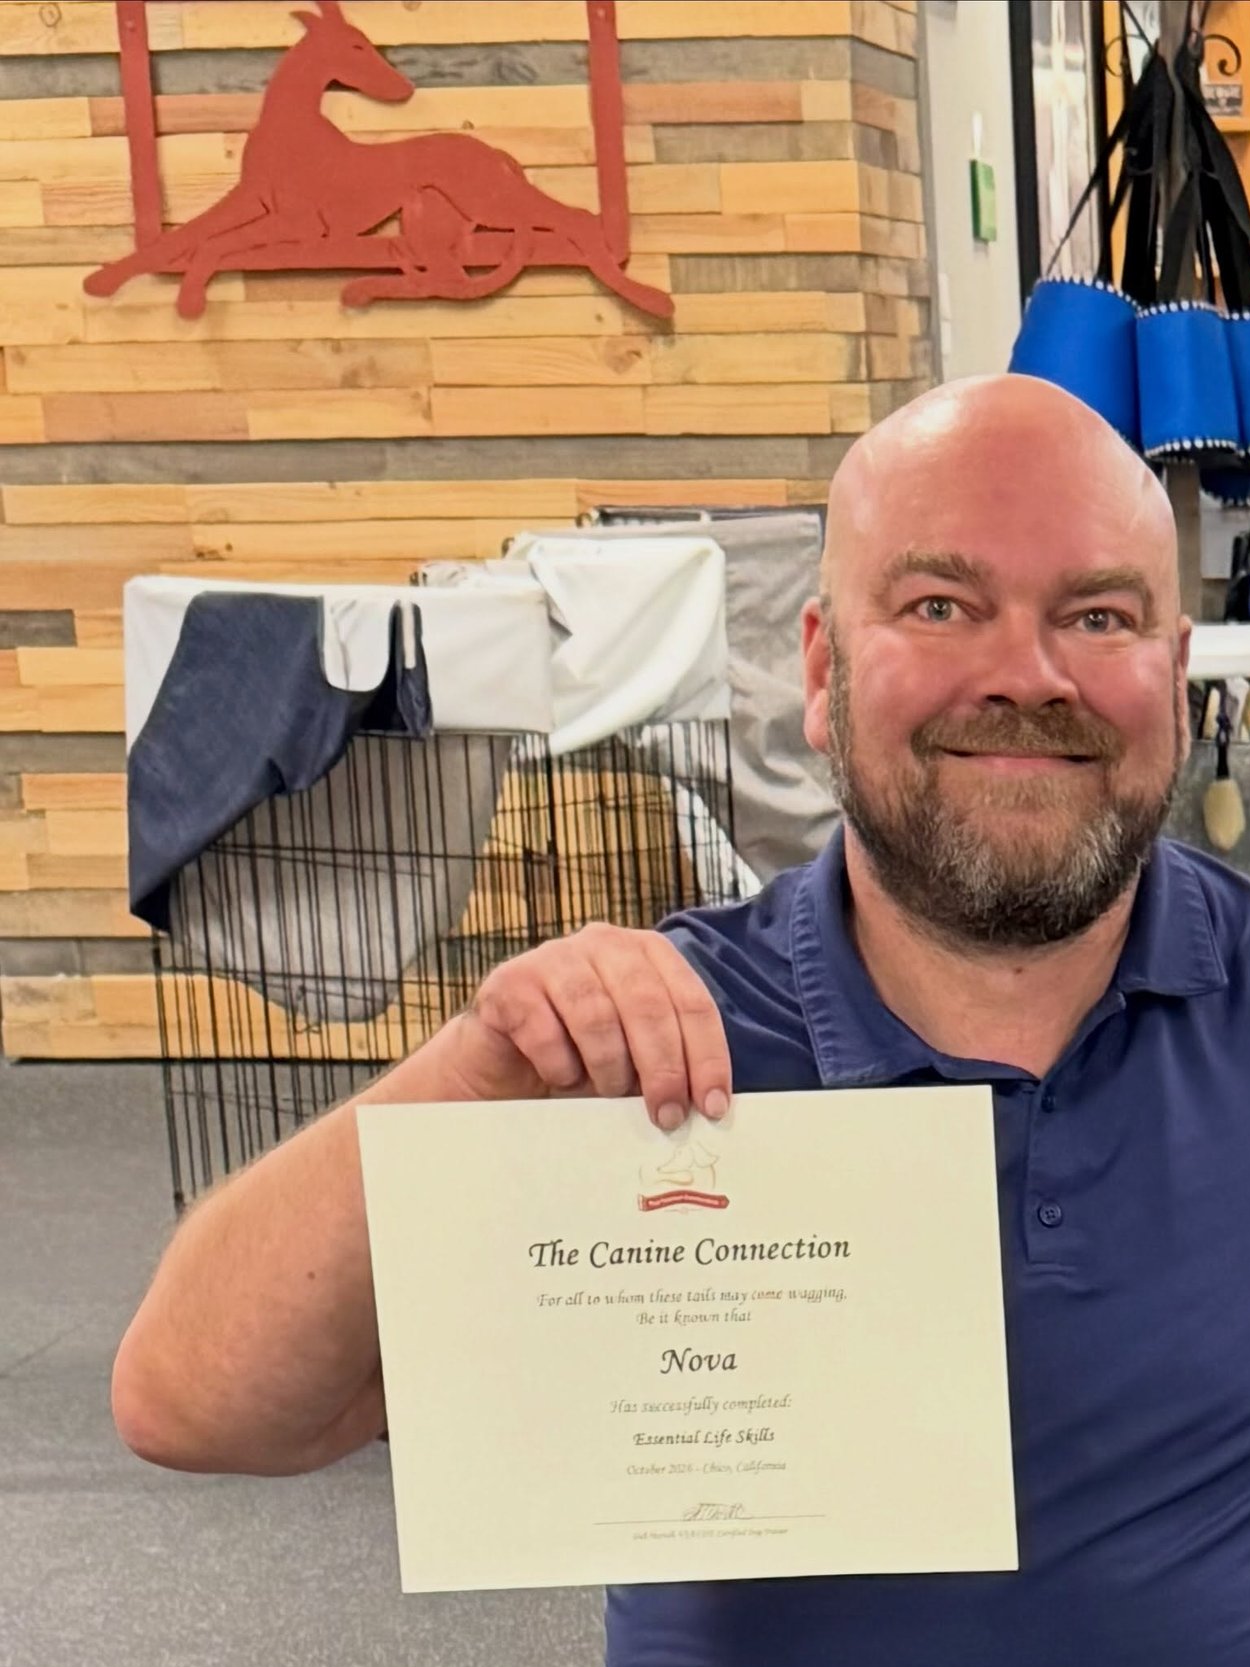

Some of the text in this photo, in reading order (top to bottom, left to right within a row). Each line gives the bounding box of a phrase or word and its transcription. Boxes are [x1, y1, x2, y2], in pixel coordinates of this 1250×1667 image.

[529, 1234, 851, 1268] The Canine Connection
[538, 1293, 562, 1307] For
[565, 1291, 584, 1306] all
[587, 1295, 600, 1306] to
[605, 1289, 644, 1304] whom
[649, 1289, 682, 1303] these
[687, 1287, 716, 1302] tails
[720, 1292, 748, 1306] may
[637, 1307, 752, 1326] Be it known that
[660, 1348, 738, 1374] Nova
[610, 1399, 637, 1413] Has
[641, 1396, 719, 1415] successfully
[633, 1427, 774, 1447] Essential Life Skills
